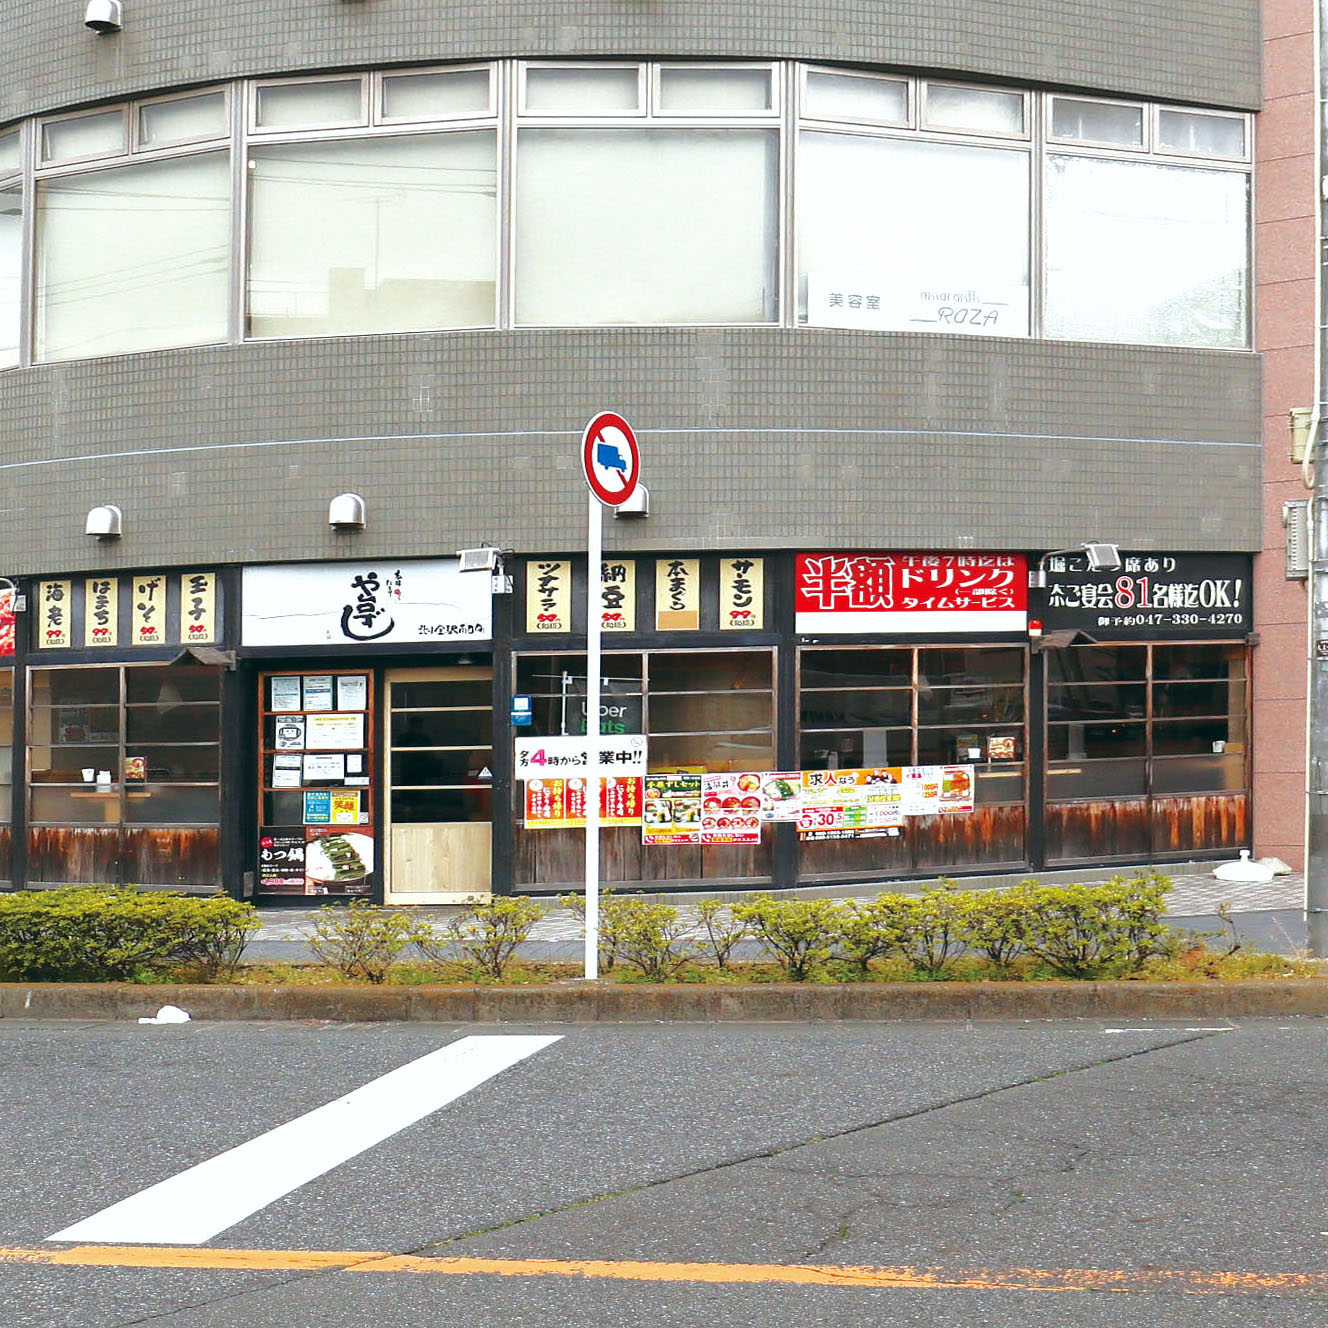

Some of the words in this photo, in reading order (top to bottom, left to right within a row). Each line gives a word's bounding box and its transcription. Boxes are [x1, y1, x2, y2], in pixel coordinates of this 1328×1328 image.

[828, 292, 881, 311] 美容室
[938, 306, 999, 327] ROZA
[137, 578, 161, 623] げそ
[188, 576, 209, 620] 玉子
[537, 563, 561, 611] ツナサラ
[601, 564, 626, 609] 納豆
[801, 555, 896, 610] 半額
[902, 568, 1014, 589] ドリンク
[46, 583, 65, 627] 海老
[92, 581, 112, 625] はまち
[901, 596, 1015, 609] タイムサービス
[809, 773, 856, 786] 求人なう
[260, 847, 304, 862] もつ鍋
